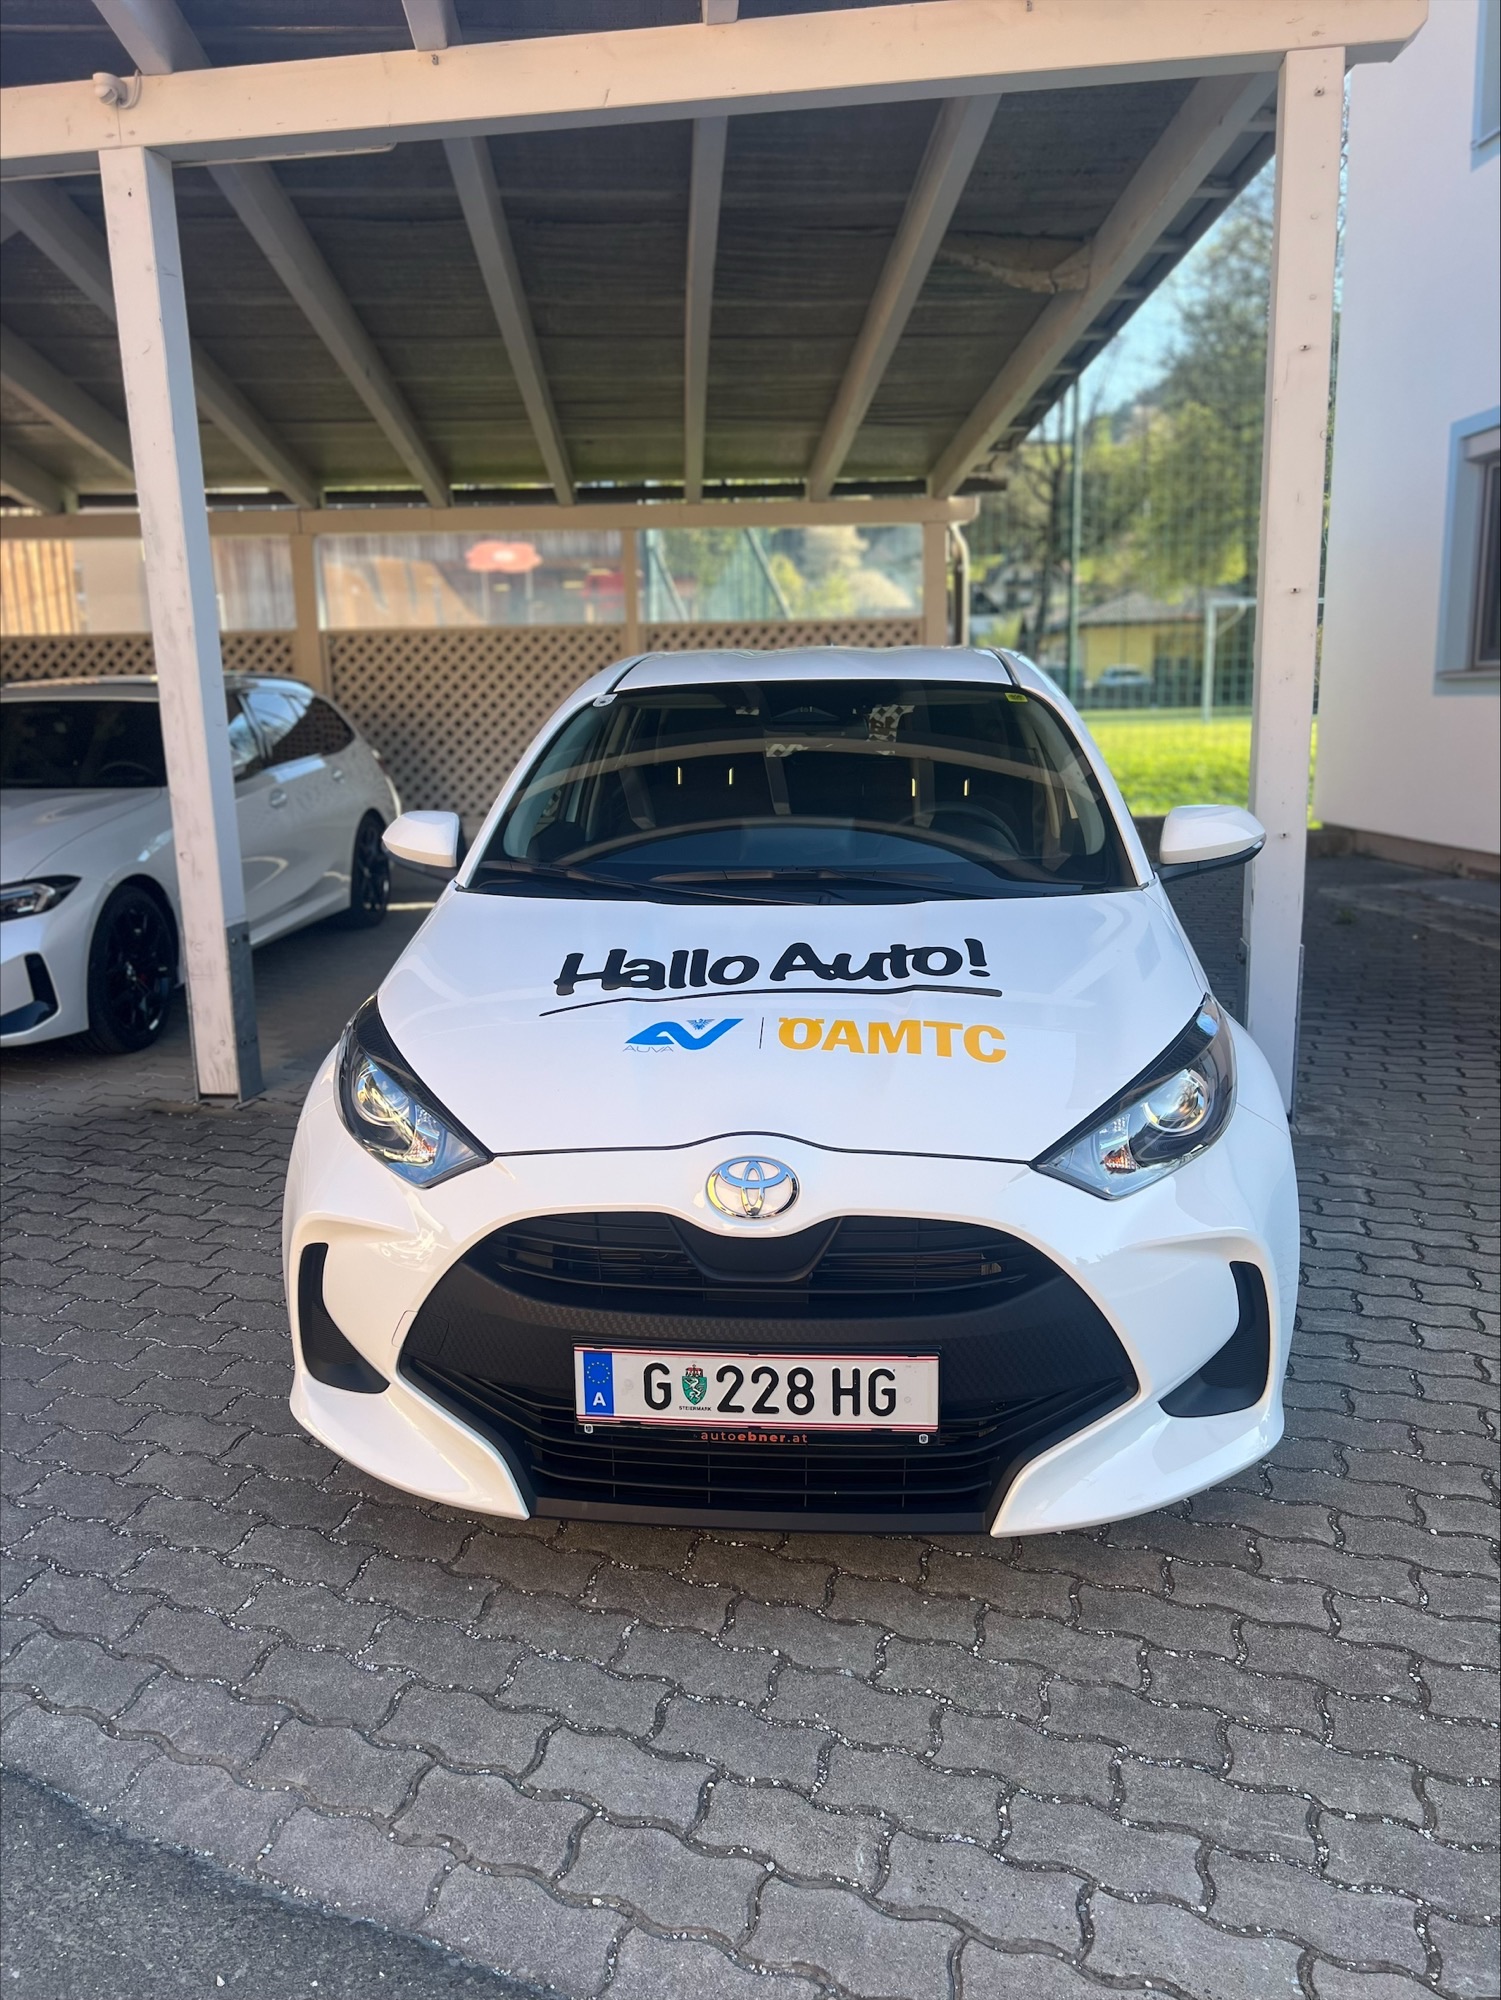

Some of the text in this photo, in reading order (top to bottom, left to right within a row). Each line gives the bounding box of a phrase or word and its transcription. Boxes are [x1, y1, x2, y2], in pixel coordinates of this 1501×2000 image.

[553, 938, 991, 996] Hallo Auto!
[622, 1044, 674, 1053] AUVA
[778, 1016, 1007, 1063] ÖAMTC
[592, 1392, 607, 1407] A
[643, 1362, 897, 1417] G 228 HG
[700, 1431, 808, 1444] autoebner.at
